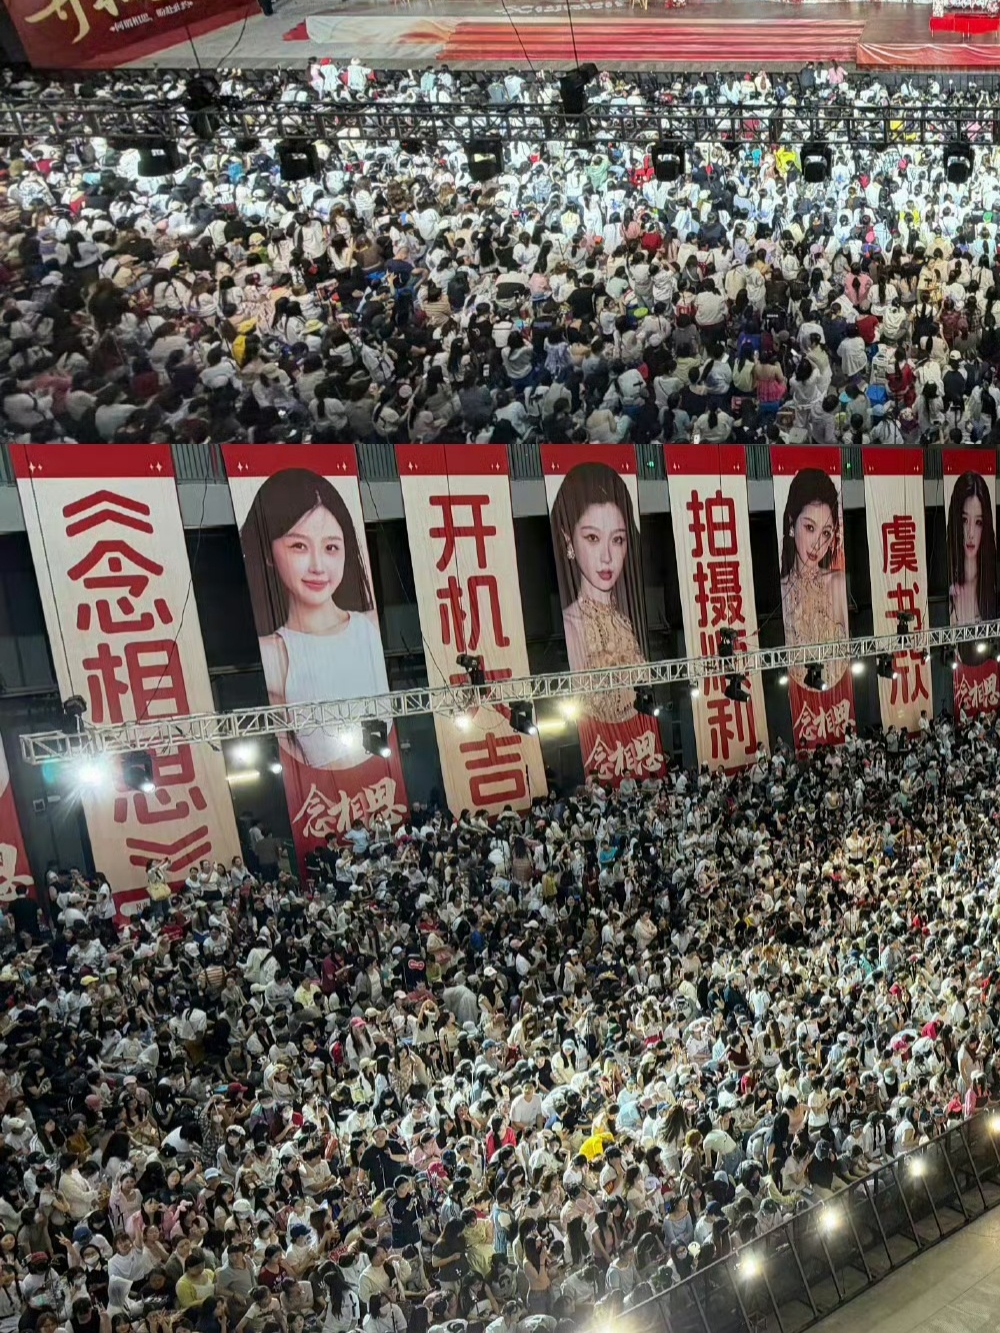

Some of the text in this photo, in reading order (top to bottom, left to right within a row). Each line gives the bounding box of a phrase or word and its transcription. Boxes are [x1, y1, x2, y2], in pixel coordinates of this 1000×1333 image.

[881, 515, 929, 705] 虞书欣
[582, 729, 664, 782] 念相思
[292, 776, 407, 838] 念相思
